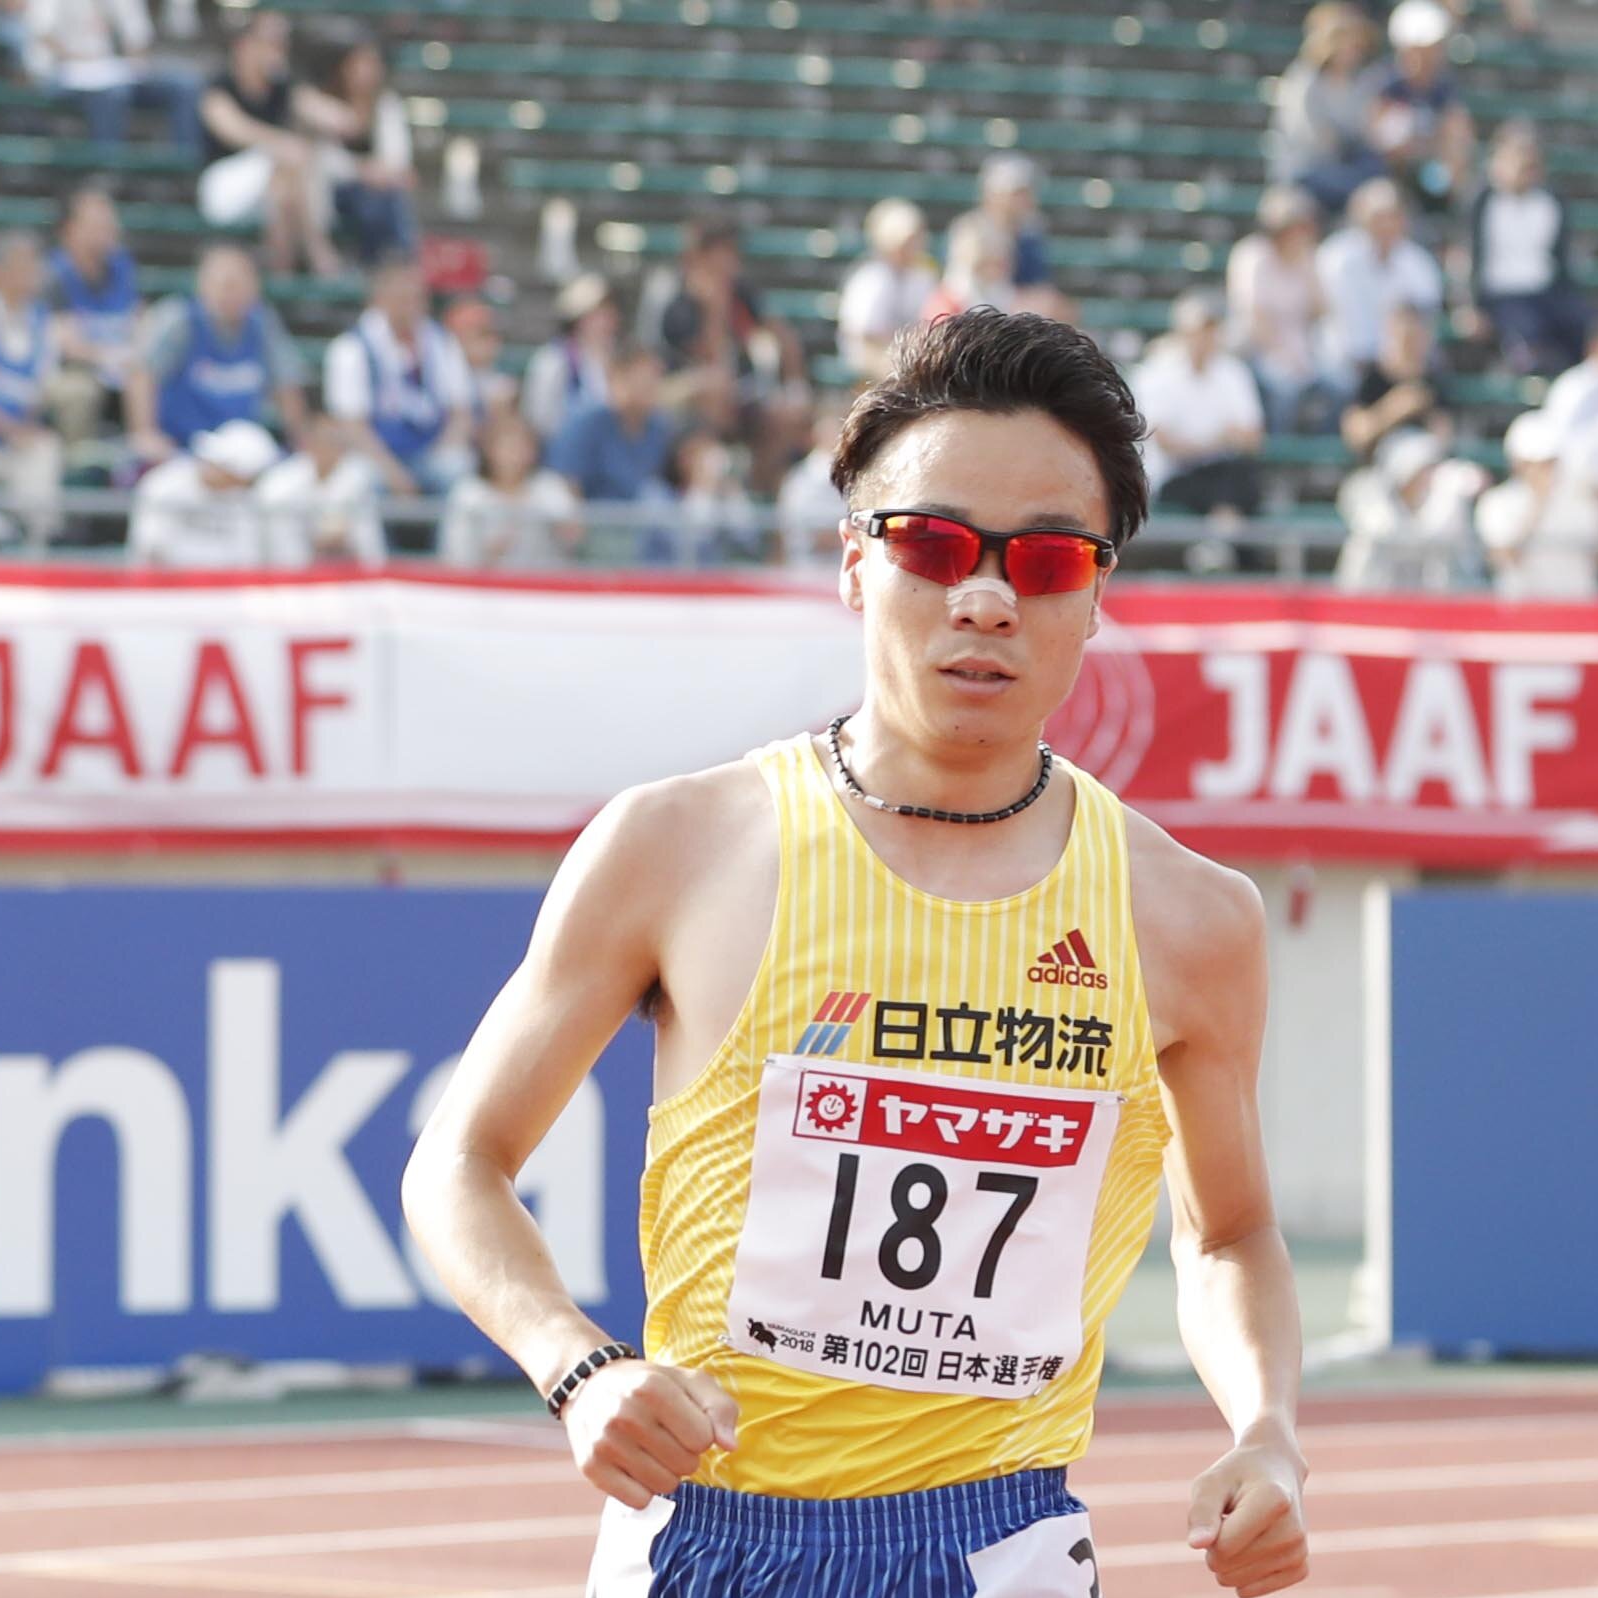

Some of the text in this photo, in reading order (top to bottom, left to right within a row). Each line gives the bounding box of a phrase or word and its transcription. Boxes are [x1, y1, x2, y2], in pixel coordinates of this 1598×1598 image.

[1190, 650, 1585, 811] JAAF
[1026, 963, 1109, 991] adidas
[873, 999, 1114, 1077] 日立物流
[877, 1093, 1080, 1155] ヤマザキ
[820, 1152, 1040, 1300] 187
[779, 1333, 815, 1353] 2018
[860, 1300, 978, 1341] MUTA
[820, 1333, 1065, 1387] 第102回 日本選手権
